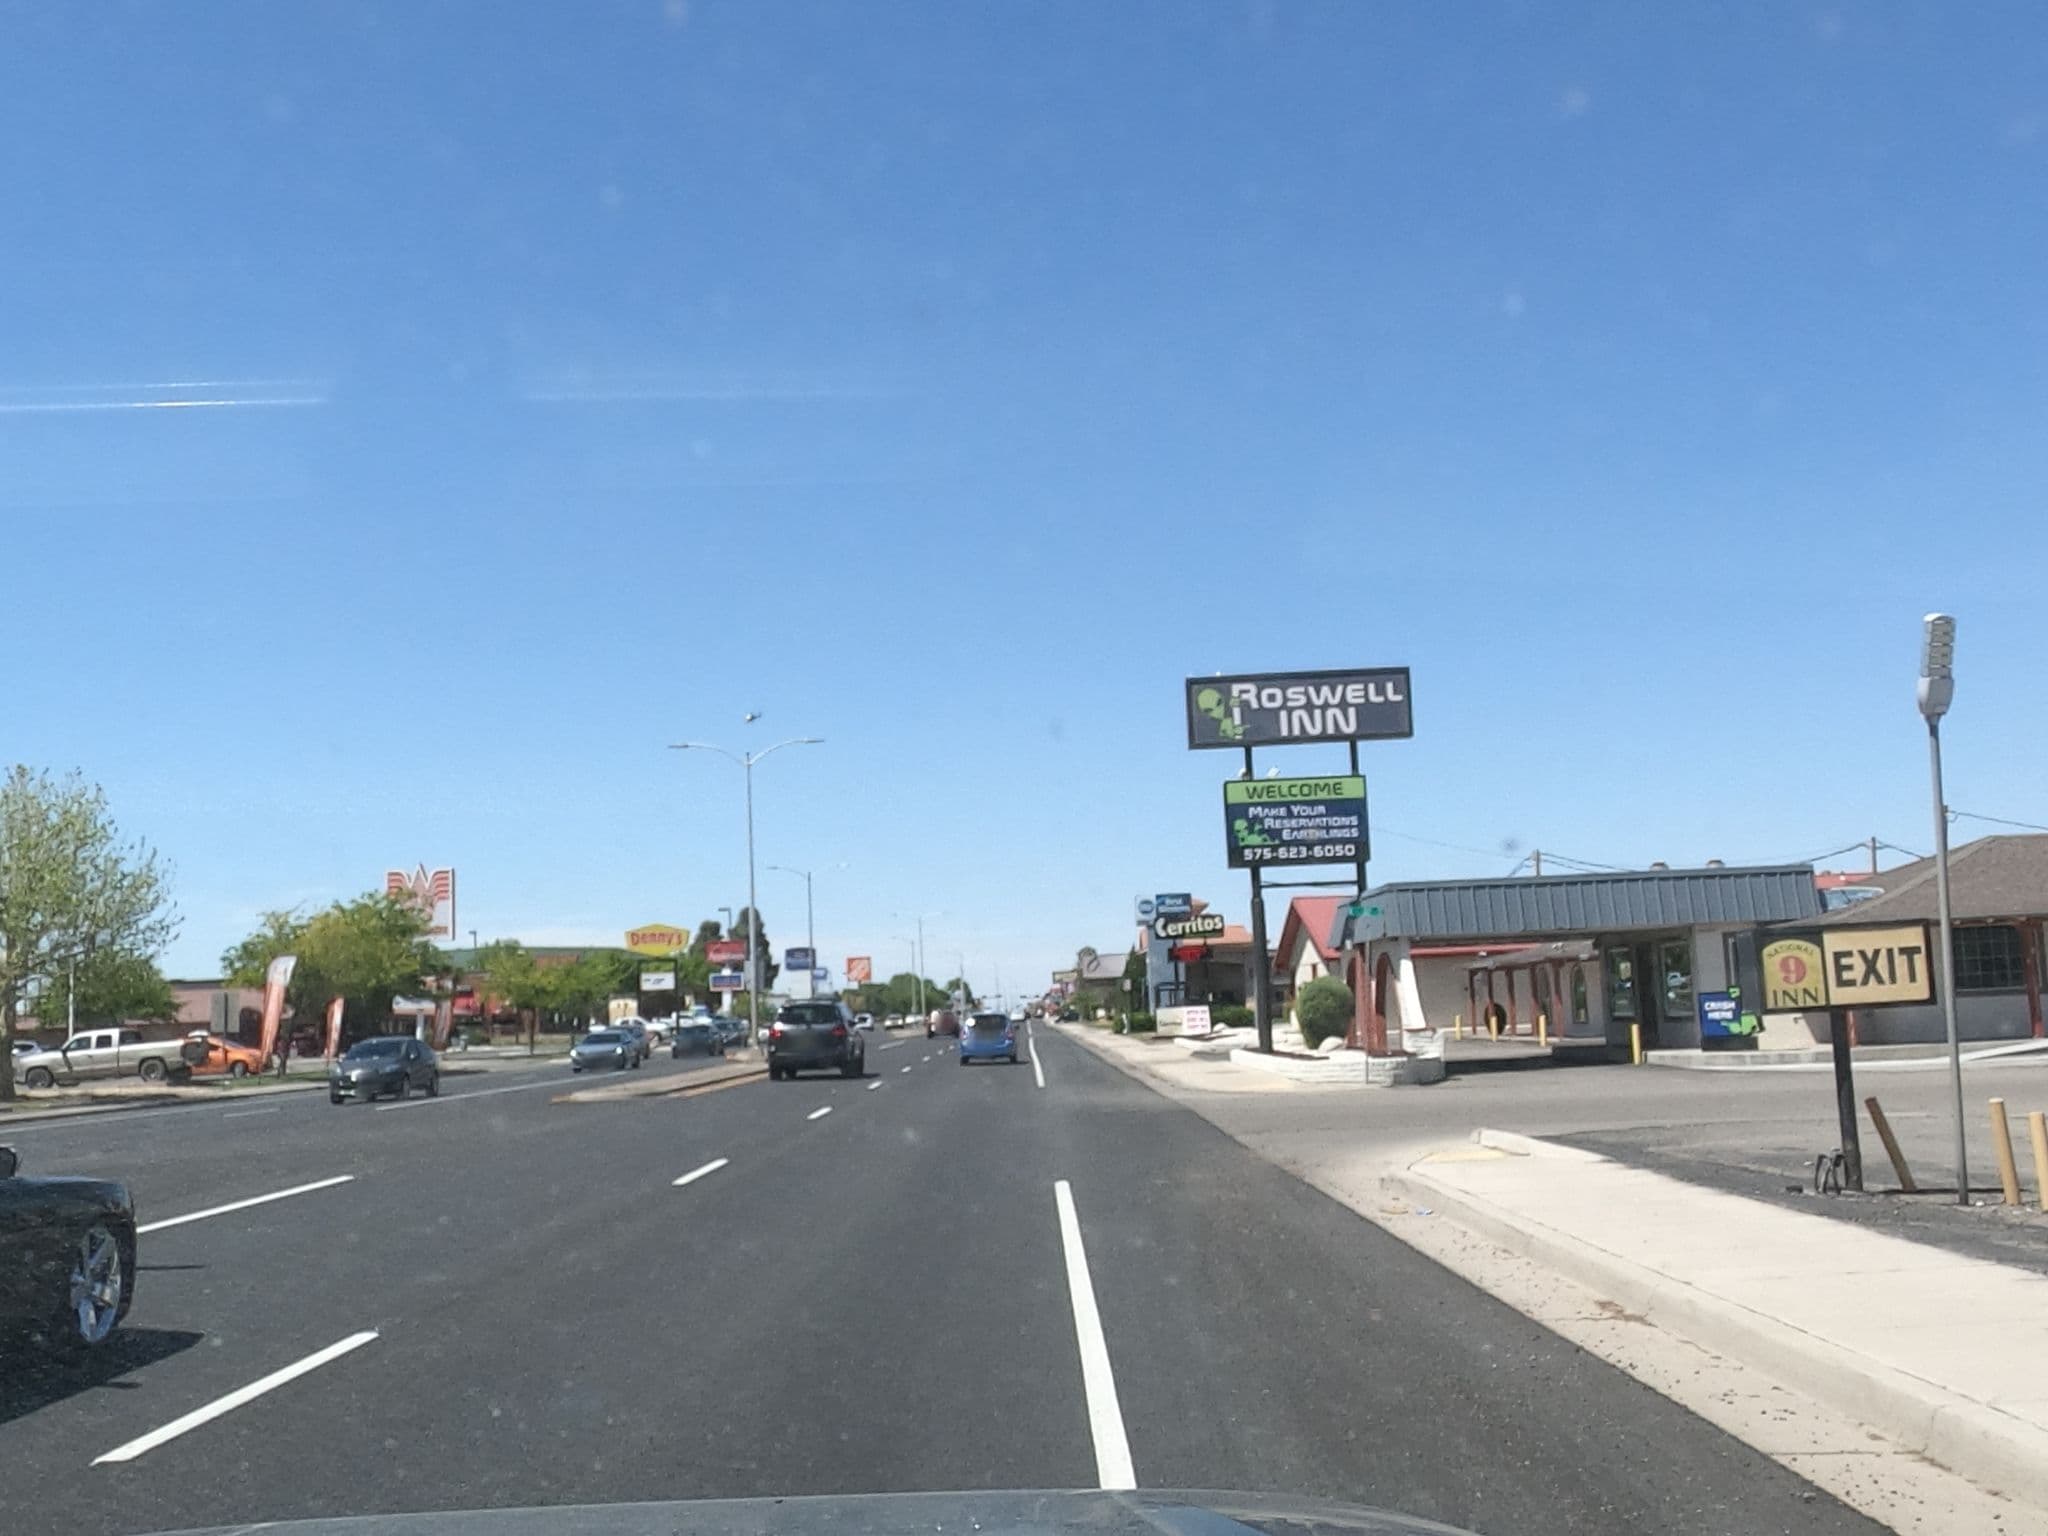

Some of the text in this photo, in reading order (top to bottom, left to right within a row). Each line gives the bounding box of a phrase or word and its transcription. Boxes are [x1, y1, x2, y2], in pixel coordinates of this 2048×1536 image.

[1231, 680, 1404, 713] ROSWELL
[1279, 706, 1358, 737] INN
[1245, 783, 1345, 800] WELCOME
[1248, 804, 1327, 818] MAKE YOUR
[1264, 815, 1359, 829] RESERVATIONS
[1243, 844, 1356, 860] 575-623-6050
[1155, 915, 1223, 938] Cerritos
[1779, 954, 1808, 985] 9
[1832, 946, 1922, 988] EXIT
[1772, 987, 1820, 1007] INN
